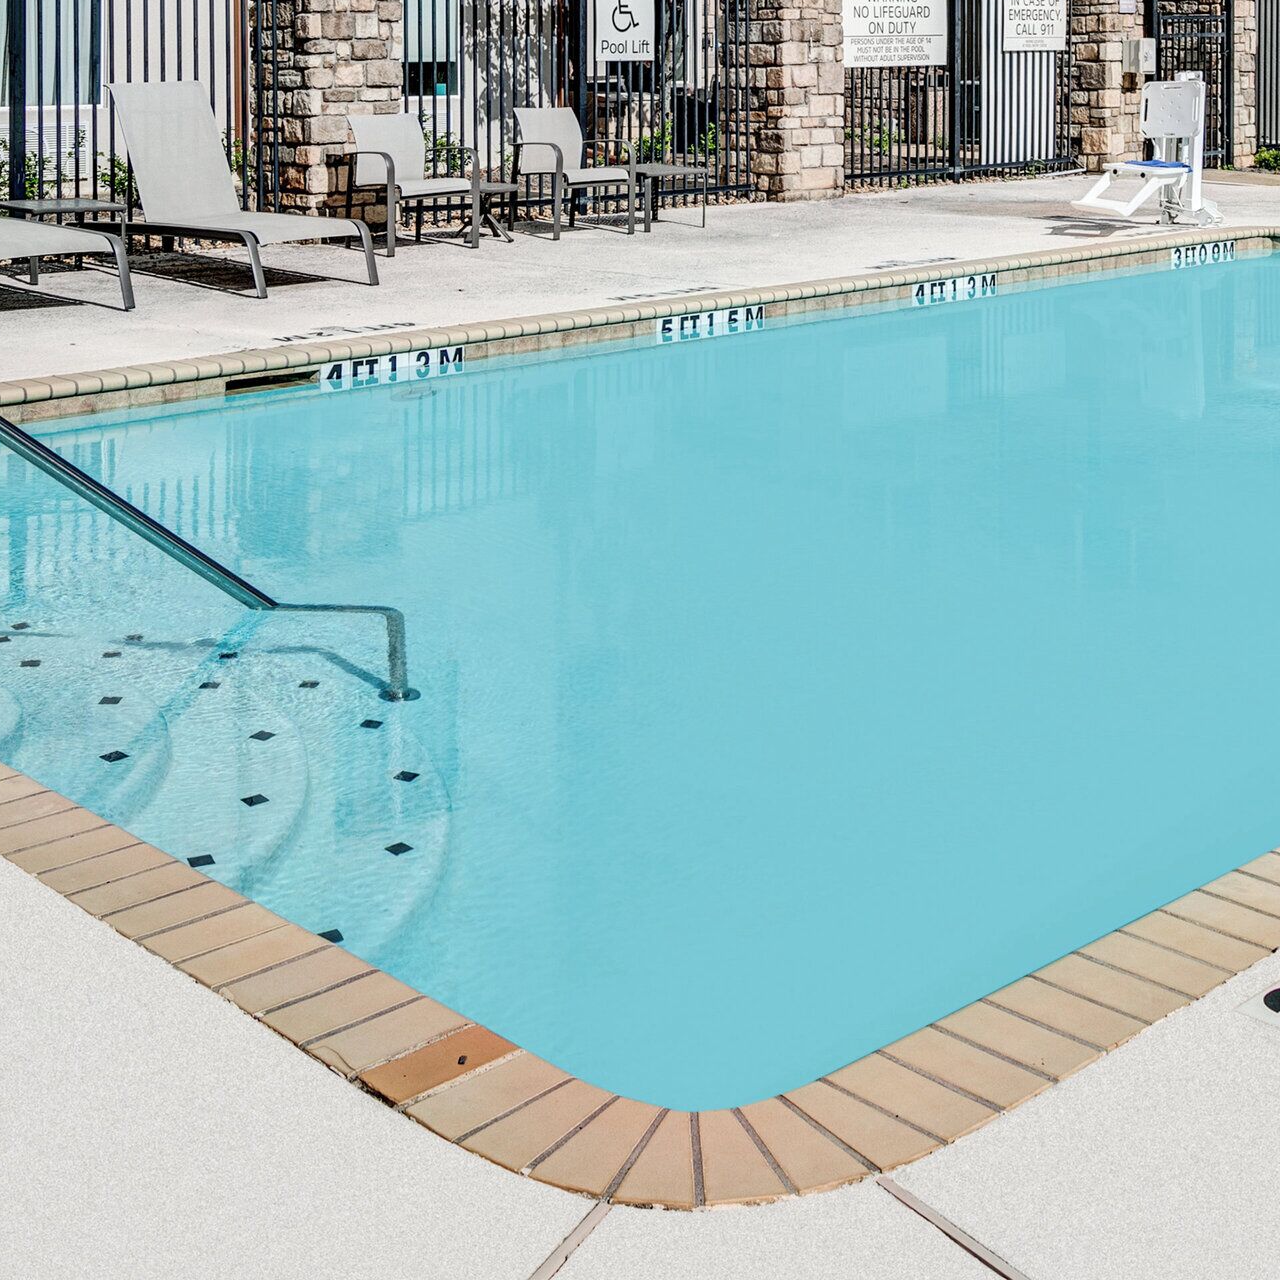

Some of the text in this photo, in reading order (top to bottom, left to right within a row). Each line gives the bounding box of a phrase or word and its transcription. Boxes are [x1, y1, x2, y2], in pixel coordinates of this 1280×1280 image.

[853, 6, 931, 18] NO LIFEGUARD
[1008, 8, 1062, 22] EMERGENCY,
[868, 21, 916, 34] ON DUTY
[1015, 23, 1054, 35] CALL 911
[601, 40, 650, 54] Pool Lift
